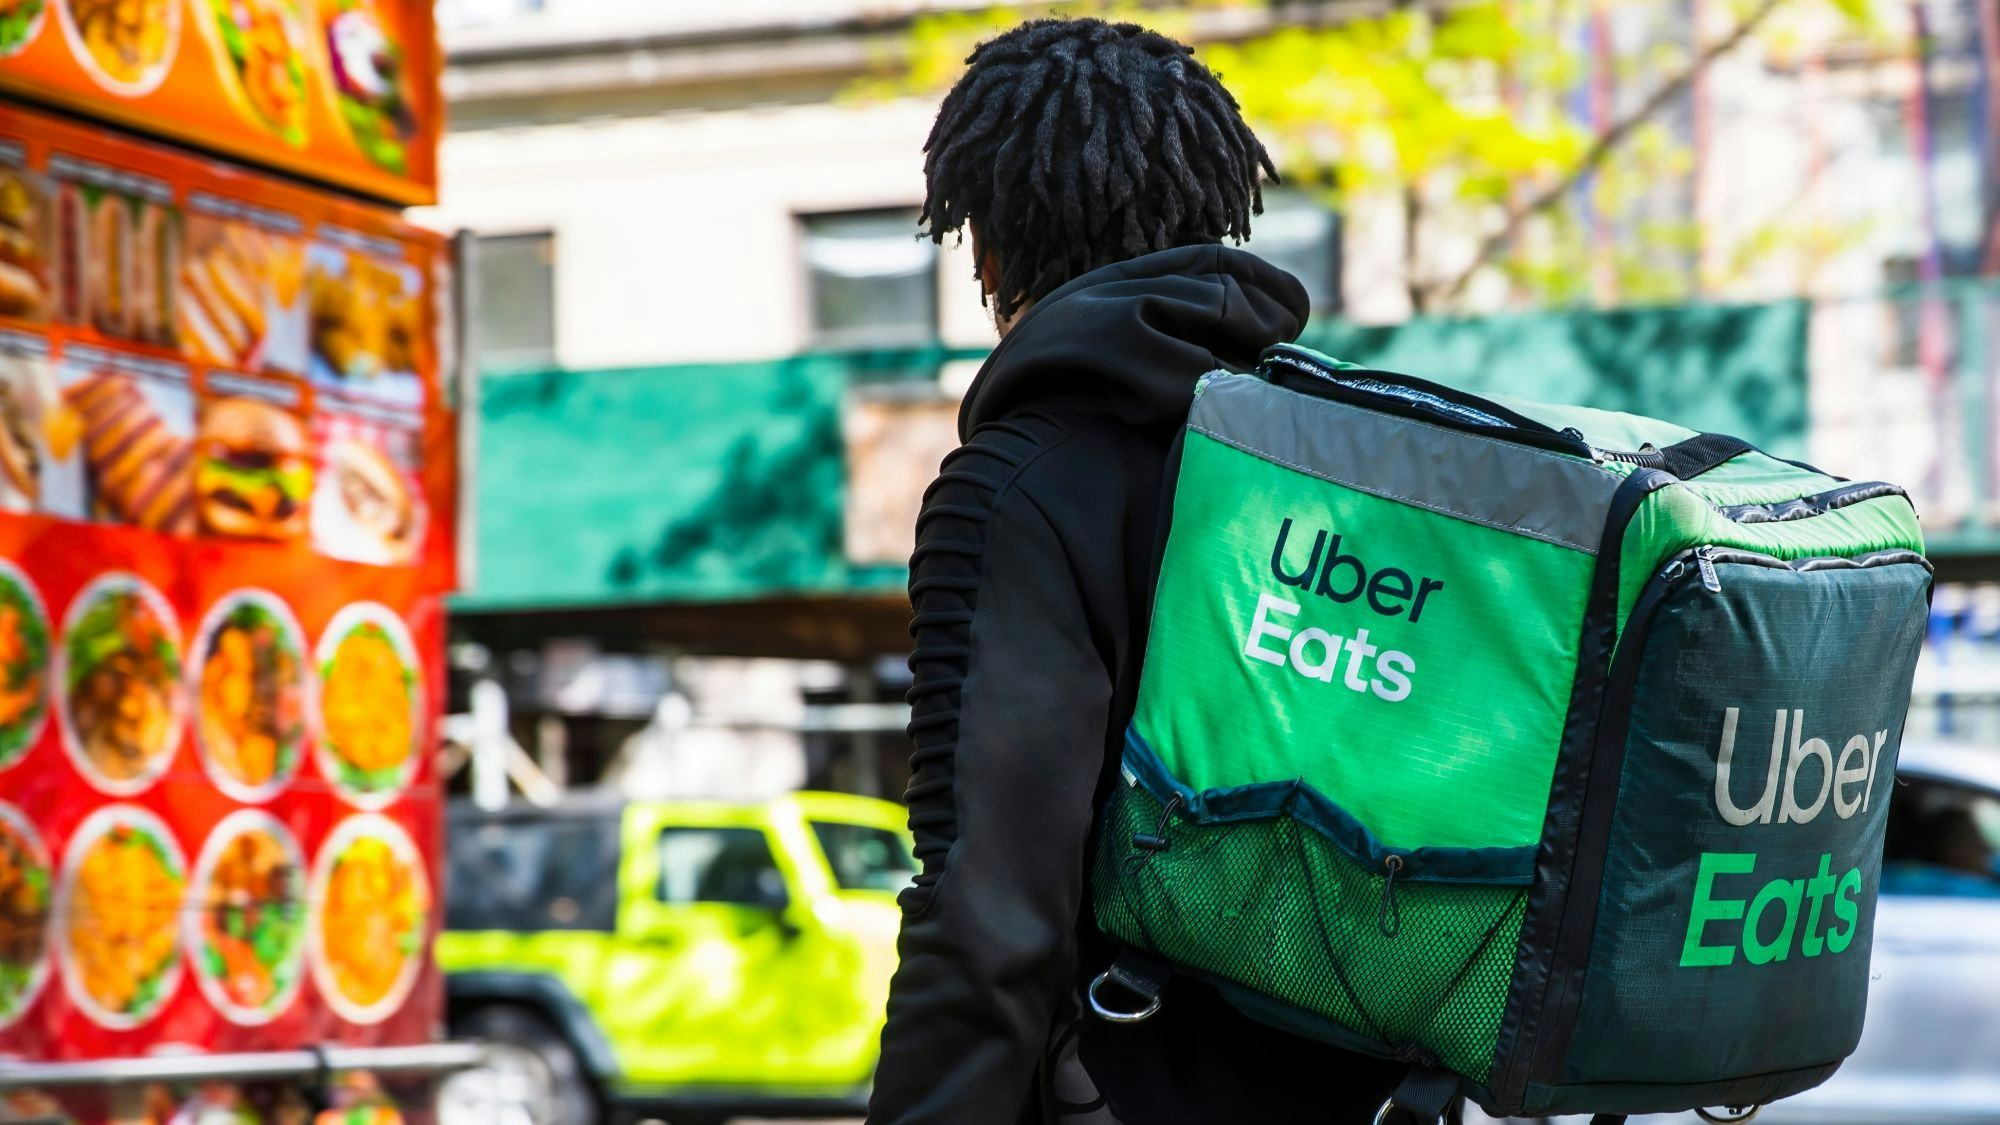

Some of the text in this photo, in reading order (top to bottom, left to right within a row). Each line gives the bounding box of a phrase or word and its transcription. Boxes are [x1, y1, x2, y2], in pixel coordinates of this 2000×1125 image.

[1271, 517, 1444, 623] Uber
[1244, 592, 1416, 702] Eats
[1714, 707, 1888, 826] Uber
[1679, 853, 1862, 967] Eats
